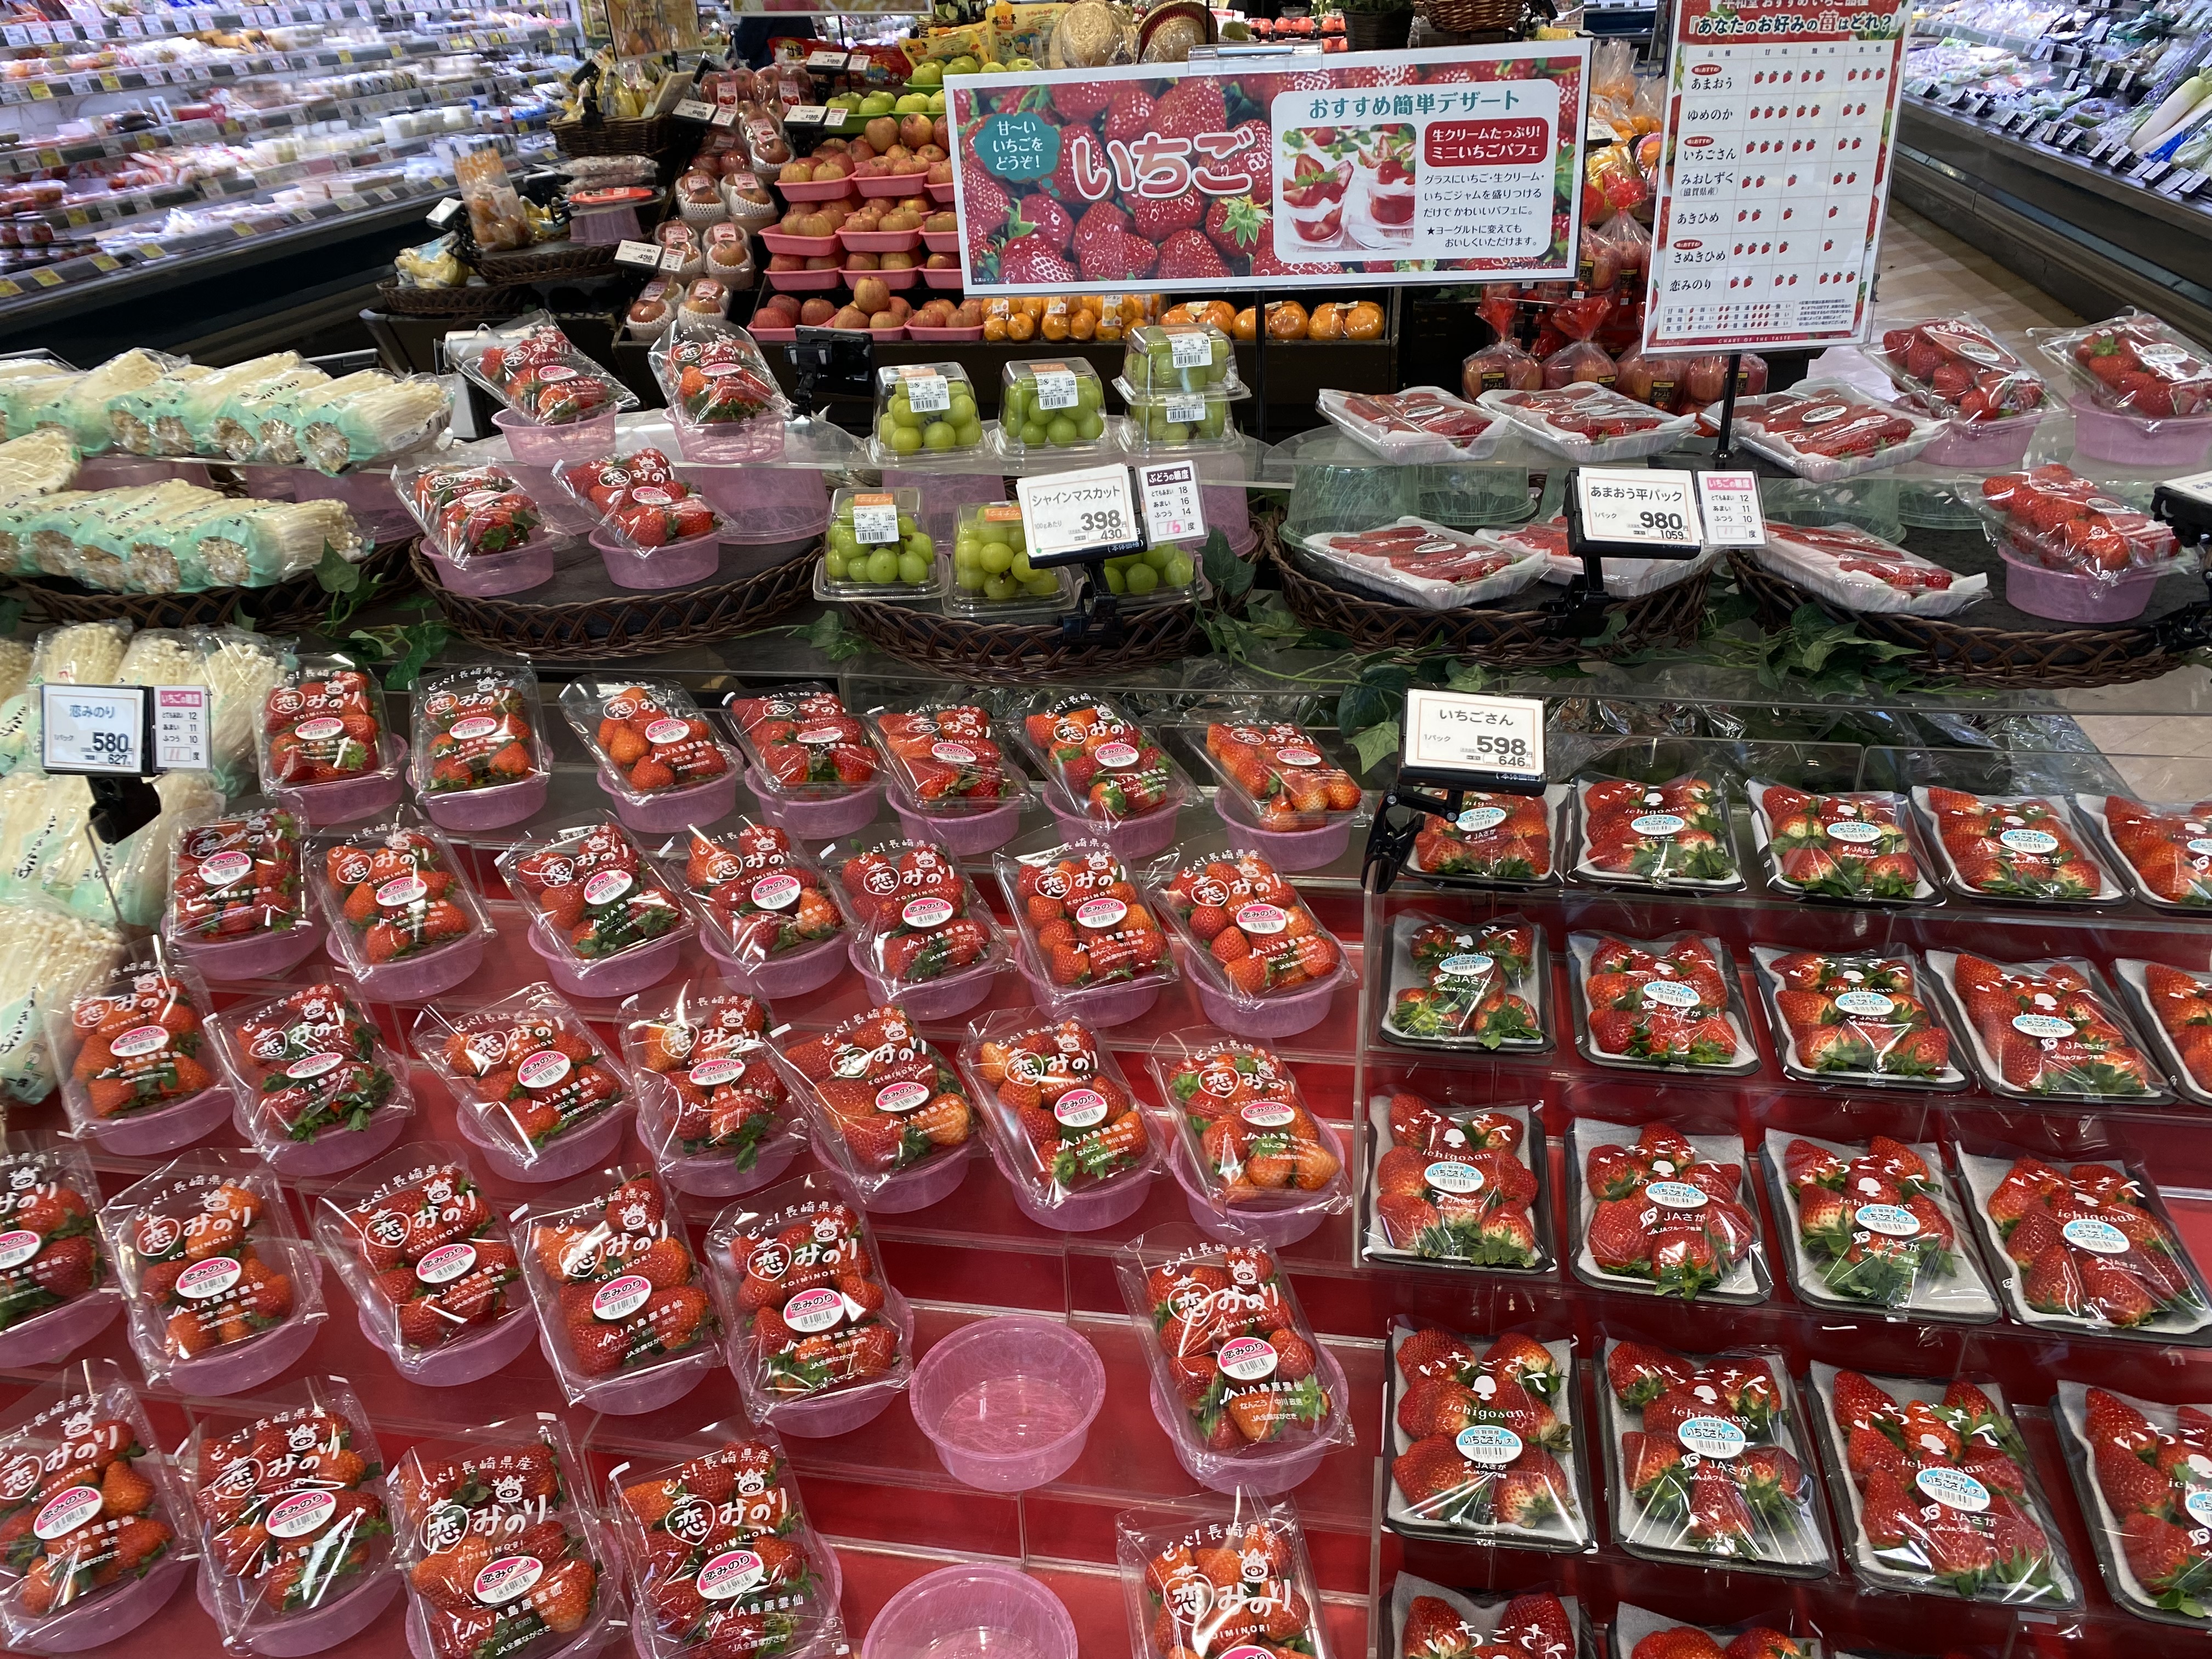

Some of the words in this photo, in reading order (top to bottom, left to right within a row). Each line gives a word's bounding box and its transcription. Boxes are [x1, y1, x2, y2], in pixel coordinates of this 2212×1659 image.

[1691, 77, 1732, 90] あまおう
[1309, 91, 1519, 119] おすすめ簡単デザート
[1687, 107, 1733, 121] ゆめのか
[1432, 126, 1540, 142] 生クリームたっぷり!
[992, 139, 1043, 153] いちごを
[1432, 144, 1538, 159] ミニいちごパフェ
[996, 155, 1040, 170] どうぞ!
[1684, 148, 1736, 161] いちごさん
[1071, 126, 1256, 200] いちご
[1425, 172, 1544, 184] グラスにいちご・生クリーム・
[1680, 171, 1734, 185] みおしずく
[1424, 189, 1541, 201] いちごジャムを盛りつける
[1424, 208, 1451, 217] だけで
[1454, 206, 1532, 216] かわいいパフェに。
[1677, 213, 1719, 225] あきひめ
[1445, 237, 1537, 247] おいしくいただけます。
[1673, 251, 1726, 263] さぬきひめ
[1669, 279, 1712, 292] 恋みのり
[1032, 486, 1120, 507] シャインマスカット
[1590, 486, 1682, 501] あまおう平パック
[1034, 520, 1062, 529] 100gあたり
[1081, 510, 1121, 531] 398
[1166, 521, 1181, 533] 16
[1188, 522, 1195, 531] 度
[1640, 511, 1683, 530] 980
[1101, 529, 1122, 540] 430
[1749, 530, 1757, 538] 度
[278, 691, 360, 710] 恋みのり
[69, 704, 115, 719] 恋みのり
[189, 712, 197, 720] 12
[1440, 709, 1514, 726] いちごさん
[1060, 716, 1133, 740] 恋みのり
[92, 731, 128, 752] 580
[1477, 735, 1526, 755] 598
[109, 754, 127, 765] 627
[193, 752, 200, 760] 度
[1498, 755, 1525, 766] 646
[346, 847, 428, 879] 恋みのり
[1209, 849, 1260, 861] 長崎県産
[868, 865, 955, 890] 恋みのり
[1042, 867, 1127, 894] 恋みのり
[756, 878, 789, 895] 恋みのり
[1198, 872, 1282, 900] 恋みのり
[895, 887, 944, 902] KOIMINORI
[909, 901, 944, 913] 恋みのり
[1242, 909, 1277, 918] 恋みのり
[1015, 1050, 1097, 1081] 恋みのり
[1059, 1094, 1095, 1110] 恋みのり
[1423, 1149, 1493, 1162] ichigosan
[393, 1165, 454, 1187] 長崎県産
[373, 1190, 476, 1244] 恋みのり
[785, 1201, 845, 1217] 長崎県産
[1664, 1212, 1706, 1222] JAさが
[143, 1207, 251, 1252] 恋みのり
[407, 1223, 464, 1254] KOIMINORI
[423, 1246, 463, 1269] 恋みのり
[755, 1238, 857, 1277] 恋みのり
[781, 1268, 840, 1289] KOIMINORI
[791, 1293, 833, 1311] 恋みのり
[1177, 1283, 1279, 1319] 恋みのり
[1223, 1341, 1263, 1360] 恋みのり
[1448, 1403, 1526, 1419] ichigosan
[704, 1449, 770, 1470] 長崎県産
[1708, 1460, 1753, 1477] JAさが
[675, 1488, 787, 1538] 恋みのり
[428, 1495, 546, 1556] 恋みのり
[707, 1526, 775, 1555] KOIMINORI
[1207, 1523, 1276, 1548] 長崎県産
[704, 1555, 750, 1582] 恋みのり
[1172, 1579, 1291, 1617] 恋みのり
